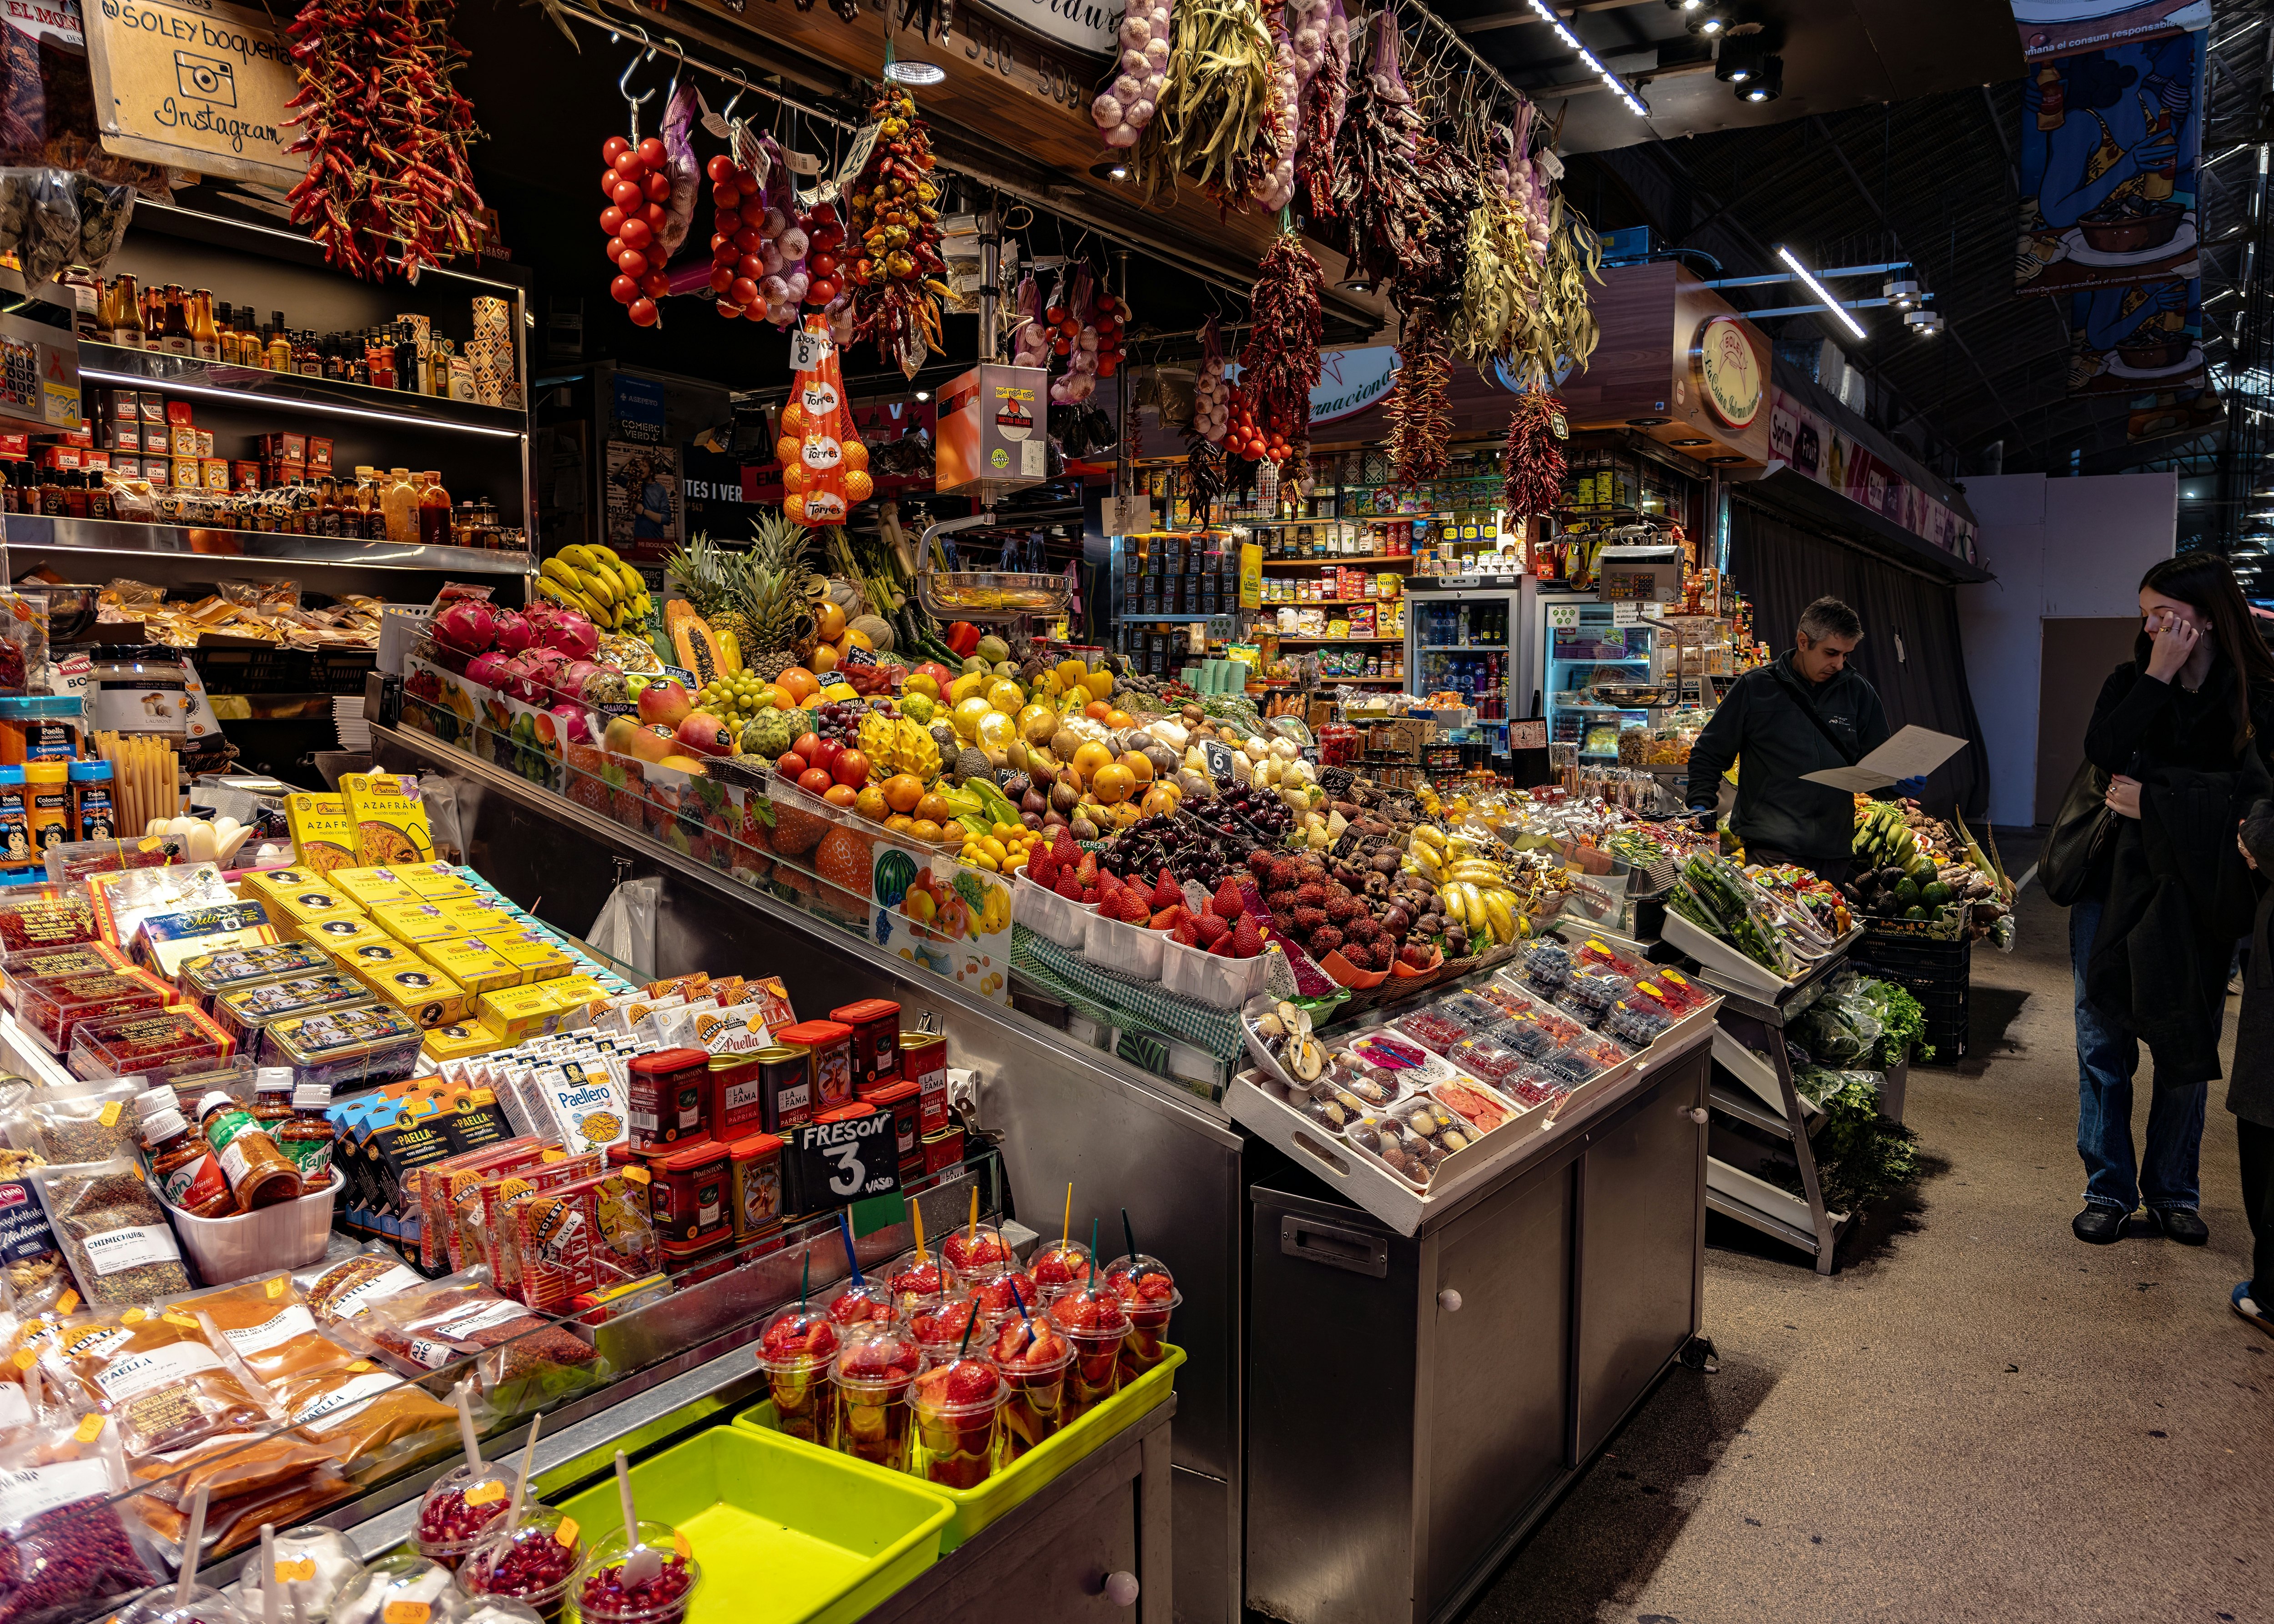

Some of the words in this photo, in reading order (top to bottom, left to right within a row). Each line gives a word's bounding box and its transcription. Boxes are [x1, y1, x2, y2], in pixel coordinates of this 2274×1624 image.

[7, 1, 34, 20] EL
[2057, 41, 2066, 49] el
[2069, 33, 2109, 47] consum
[2113, 20, 2177, 38] responsable
[202, 20, 294, 65] boqueria
[966, 15, 1013, 76] 510
[1038, 55, 1081, 109] 509
[155, 97, 284, 152] Instagram
[845, 139, 872, 174] 10
[797, 345, 809, 364] 8
[805, 392, 835, 406] Torres
[1711, 373, 1727, 410] Cuina
[806, 445, 838, 459] Torres
[720, 484, 743, 502] VER
[809, 503, 840, 516] Torres
[852, 649, 876, 664] Castanya
[821, 675, 842, 686] GOLDEN
[604, 704, 628, 712] MANGO
[1208, 744, 1231, 755] CHERRIES
[1213, 754, 1225, 770] 6
[1001, 769, 1030, 781] FIGUES
[1326, 768, 1354, 781] LITCHIS
[363, 800, 417, 809] AZAFRÁN
[1082, 841, 1105, 849] CEREZA
[95, 893, 111, 933] AZAFRAN
[702, 1021, 722, 1041] SOLEY
[711, 1034, 727, 1051] PACK
[924, 1075, 933, 1084] LA
[924, 1078, 944, 1091] FAMA
[558, 1086, 610, 1109] Paellero
[733, 1088, 743, 1098] LA
[734, 1092, 757, 1104] FAMA
[785, 1091, 795, 1100] LA
[785, 1095, 807, 1106] FAMA
[925, 1094, 940, 1103] SWEET
[921, 1096, 945, 1109] PAPRIKA
[728, 1111, 757, 1124] PAPRIKA
[734, 1107, 751, 1116] SWEET
[925, 1106, 940, 1116] SMOKED
[457, 1113, 490, 1128] PAELLA
[780, 1113, 808, 1126] PAPRIKA
[397, 1128, 433, 1146] PAELLA
[803, 1112, 892, 1150] FRESON
[823, 1141, 866, 1196] 3
[865, 1177, 895, 1194] VASO
[537, 1201, 565, 1239] SOLEY
[558, 1217, 578, 1242] PACK
[88, 1232, 146, 1249] CHIMICHURRI
[332, 1276, 382, 1311] CHILLI
[100, 1358, 153, 1384] PAELLA
